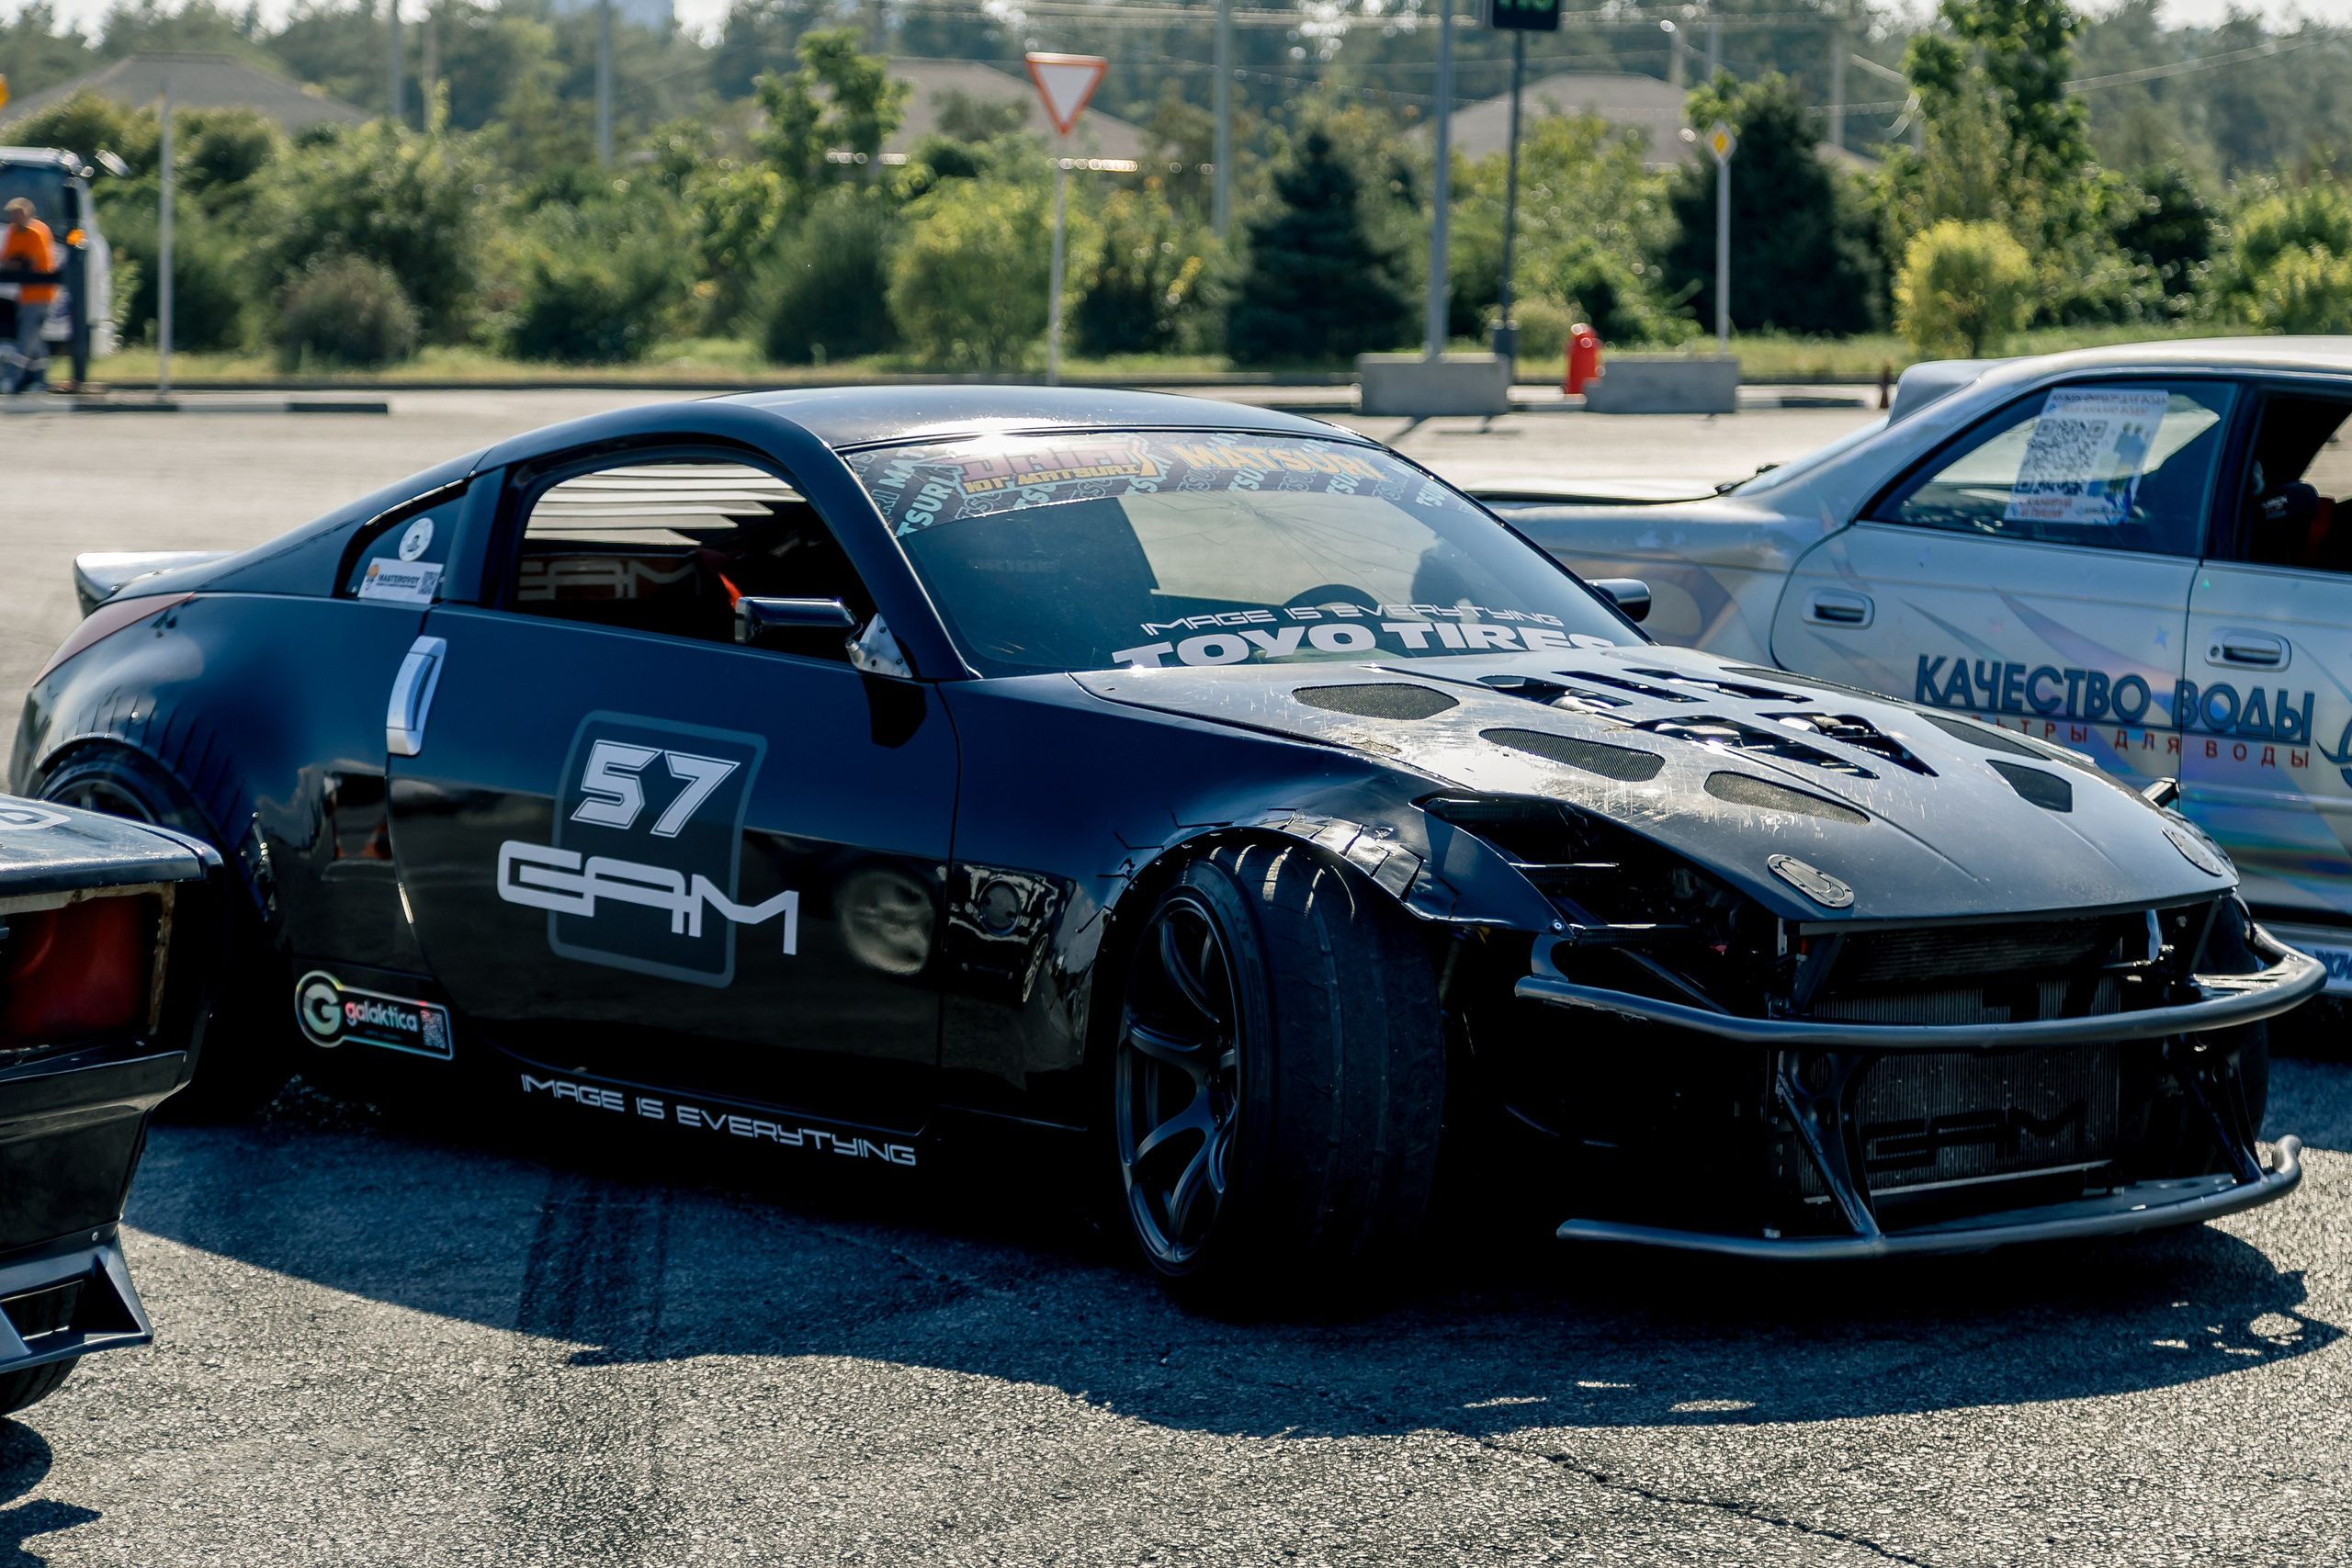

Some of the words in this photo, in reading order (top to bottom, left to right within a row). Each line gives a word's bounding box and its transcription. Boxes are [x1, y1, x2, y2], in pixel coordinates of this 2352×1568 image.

[1017, 464, 1143, 486] MATSURI
[1167, 445, 1387, 480] MATSURI
[1140, 609, 1277, 637] IMAGE
[1283, 606, 1323, 620] IS
[1329, 604, 1565, 627] EVERYTYING
[1112, 623, 1376, 667] TOYO
[1916, 653, 2152, 724] КАЧЕСТВО
[2171, 677, 2316, 743] ВОДЫ
[2113, 728, 2180, 756] ДЛЯ
[2205, 740, 2311, 769] ВОДЫ
[570, 739, 741, 838] 57
[497, 840, 799, 955] GAM
[345, 998, 420, 1032] galaktica
[521, 1073, 625, 1112] IMAGE
[636, 1096, 665, 1120] IS
[676, 1105, 916, 1167] EVERYTYING
